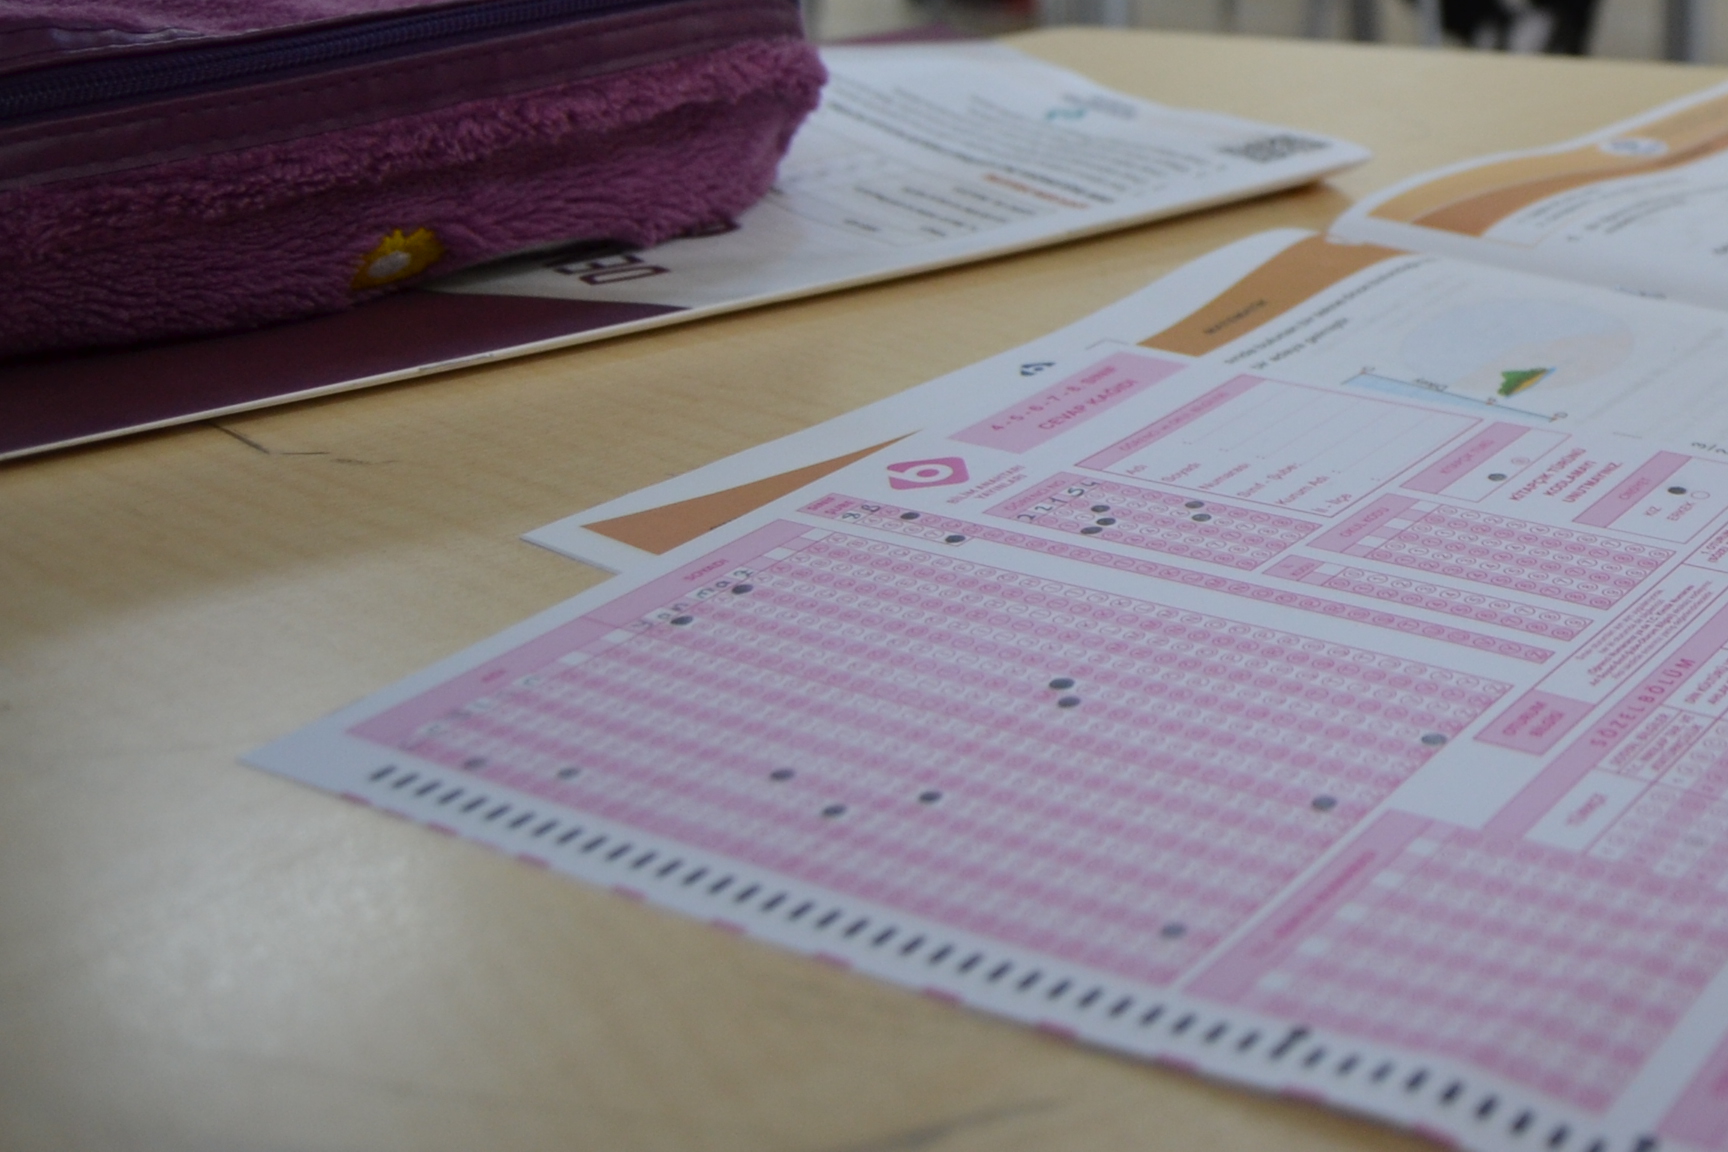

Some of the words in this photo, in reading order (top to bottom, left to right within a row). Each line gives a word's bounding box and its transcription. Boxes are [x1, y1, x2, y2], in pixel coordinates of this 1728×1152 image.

[1038, 405, 1086, 430] CEVAP
[1666, 501, 1695, 522] ERKEK
[1590, 705, 1646, 748] SÖZEL
[1637, 657, 1697, 705] BÖLÜM
